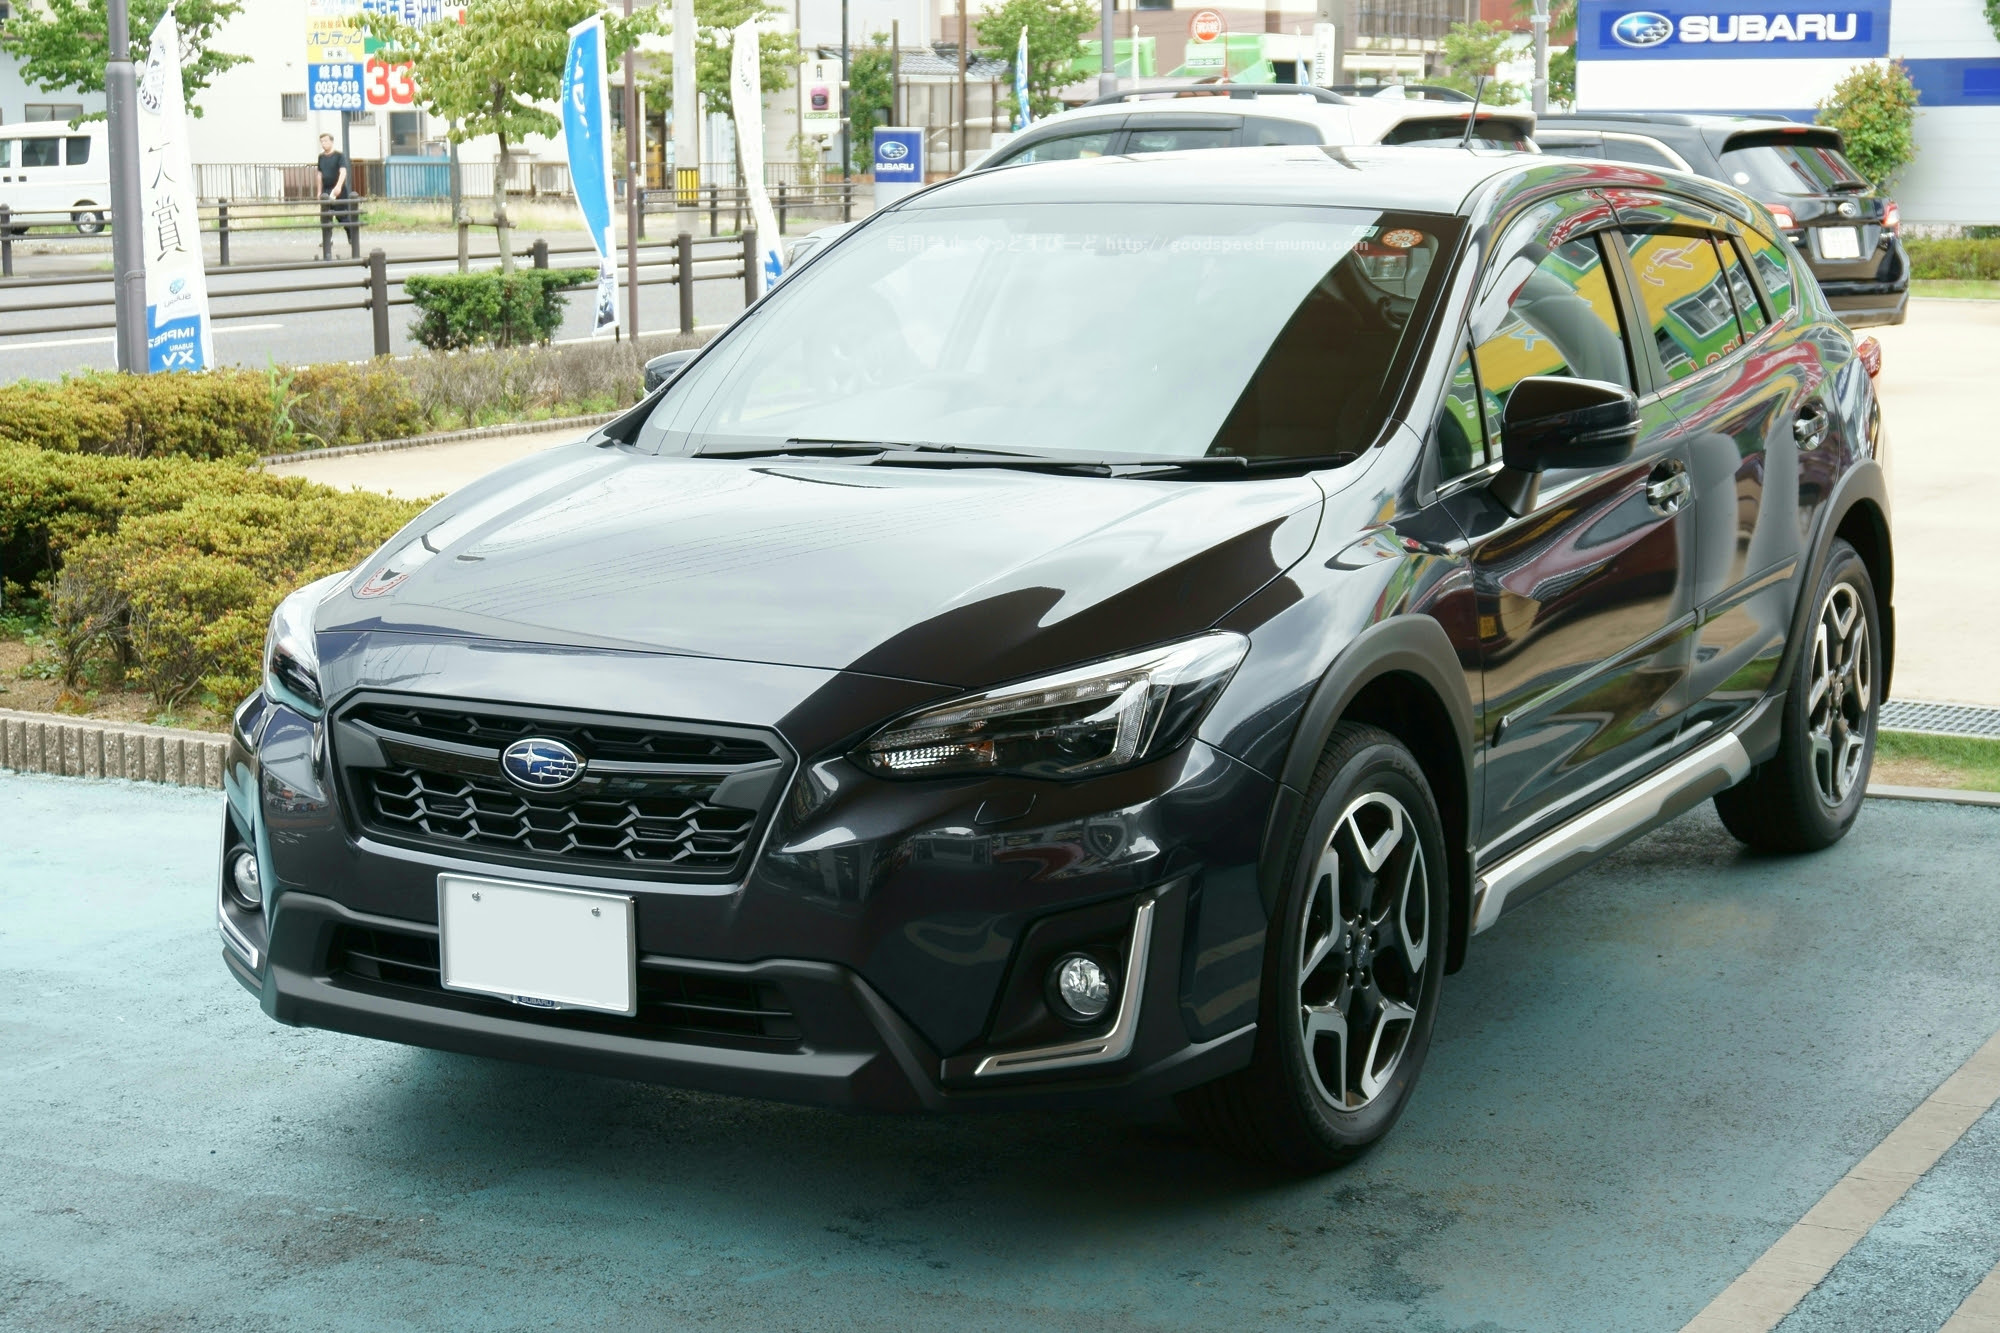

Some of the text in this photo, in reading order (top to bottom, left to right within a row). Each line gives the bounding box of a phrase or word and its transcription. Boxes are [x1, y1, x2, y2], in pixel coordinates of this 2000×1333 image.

[1678, 13, 1857, 42] SUBARU
[307, 30, 363, 45] オンテック
[315, 81, 359, 94] 0037-619
[366, 57, 415, 105] 33
[313, 93, 361, 108] 90926
[875, 163, 915, 171] SUBARU
[521, 996, 552, 1006] SUBARU
